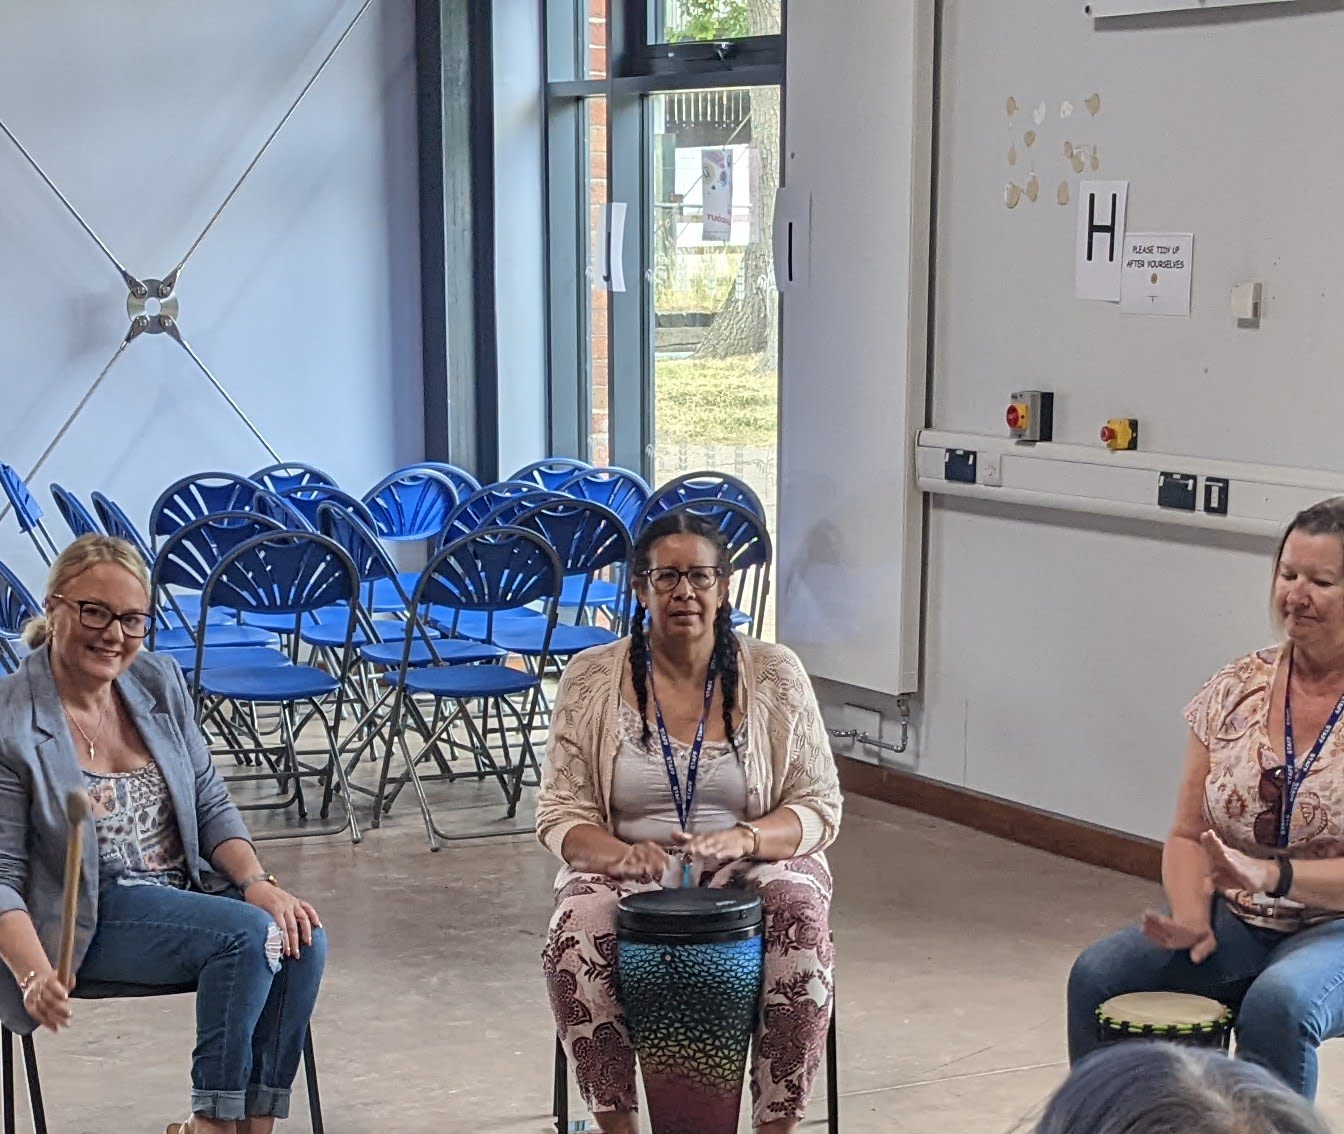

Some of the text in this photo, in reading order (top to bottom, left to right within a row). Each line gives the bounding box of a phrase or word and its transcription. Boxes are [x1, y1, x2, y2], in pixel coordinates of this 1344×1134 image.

[1086, 193, 1117, 262] H
[1132, 245, 1180, 255] PLEASE TIDY UP
[1126, 260, 1185, 269] AFTER YOURSELVES
